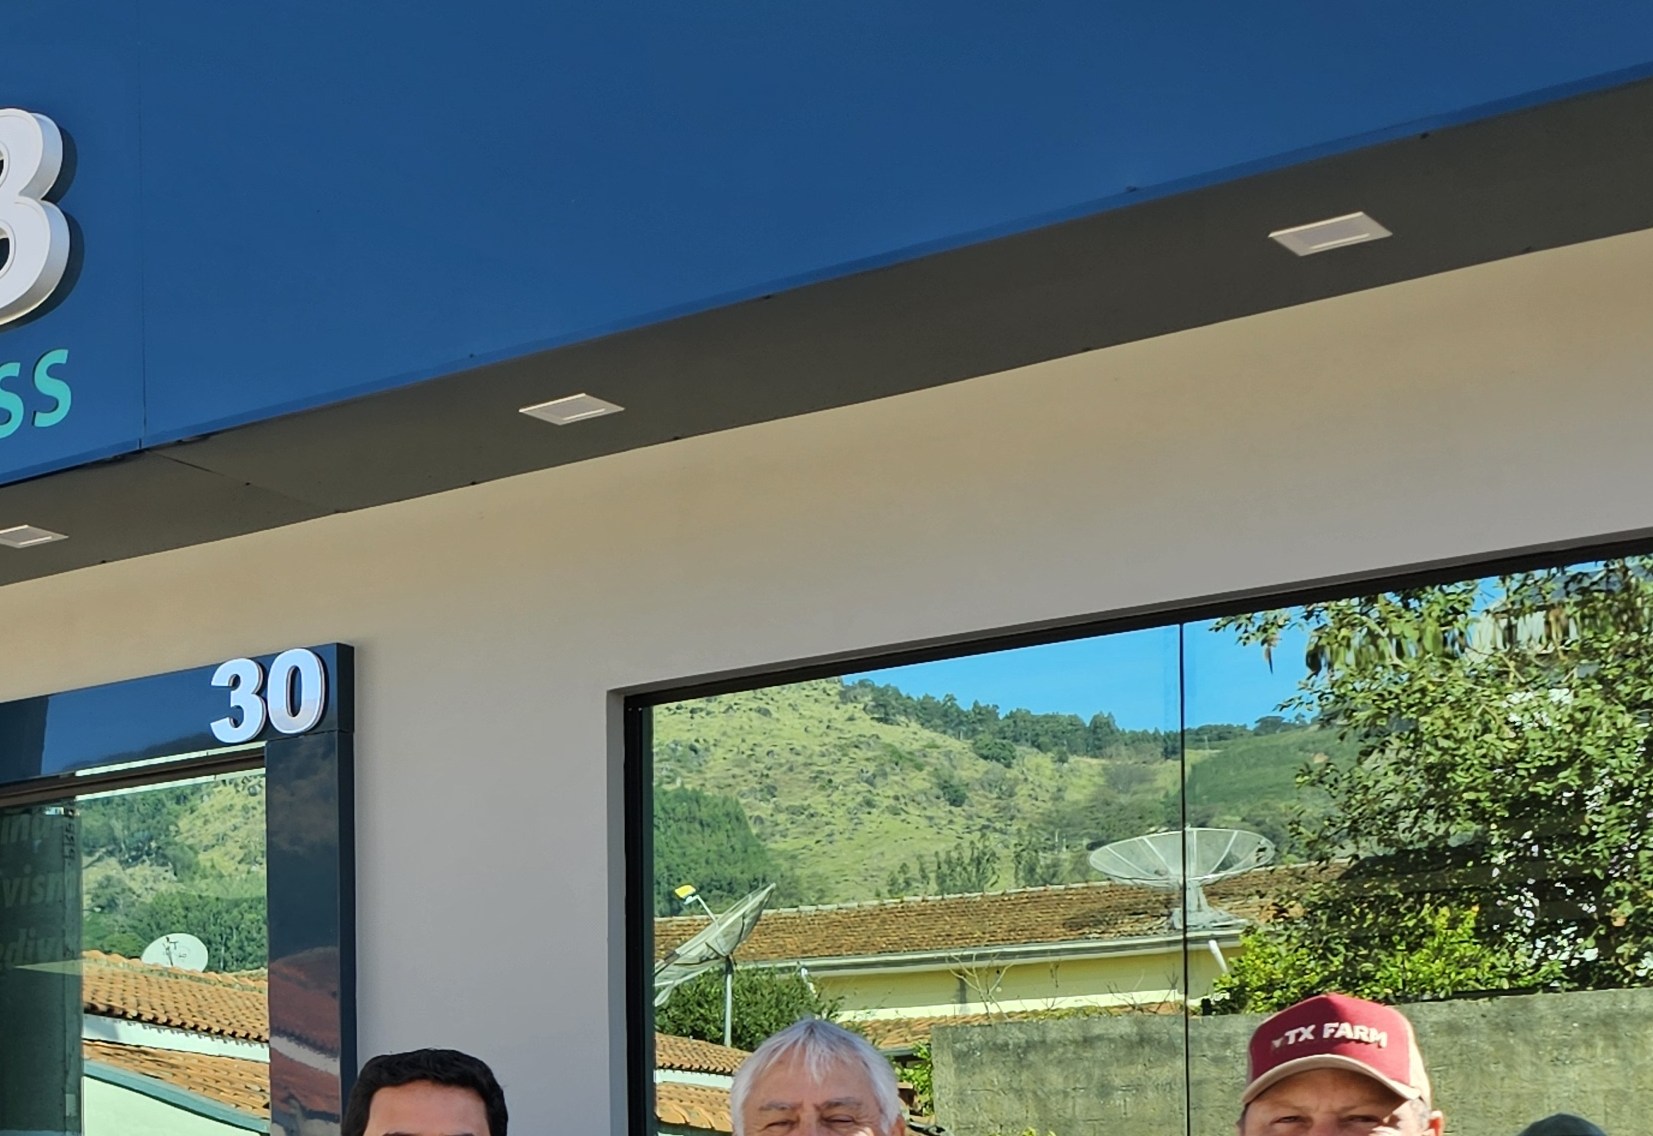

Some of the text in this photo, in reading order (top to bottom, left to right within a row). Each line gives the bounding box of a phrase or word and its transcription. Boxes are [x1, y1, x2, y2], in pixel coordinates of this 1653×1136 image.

[210, 648, 325, 743] 30
[1284, 1021, 1388, 1048] TX FARM
